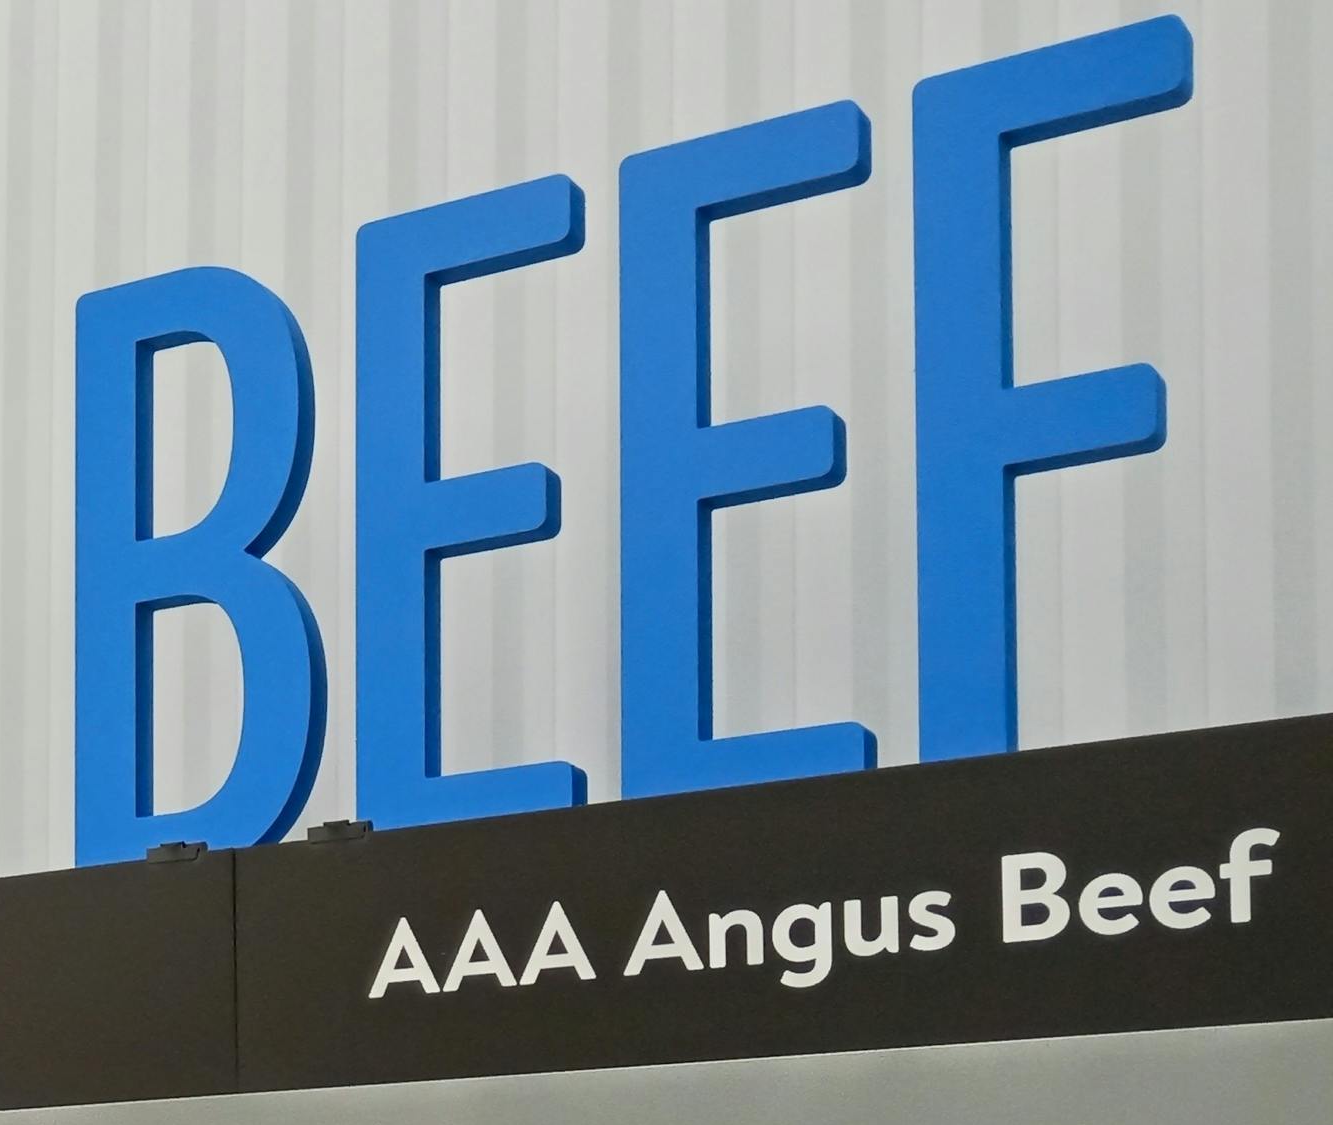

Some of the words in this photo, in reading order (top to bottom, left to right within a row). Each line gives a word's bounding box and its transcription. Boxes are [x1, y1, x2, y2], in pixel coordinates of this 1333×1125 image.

[75, 13, 1193, 868] BEEF
[369, 899, 597, 998] AAA
[623, 883, 957, 989] Angus
[1001, 827, 1282, 944] Beef
